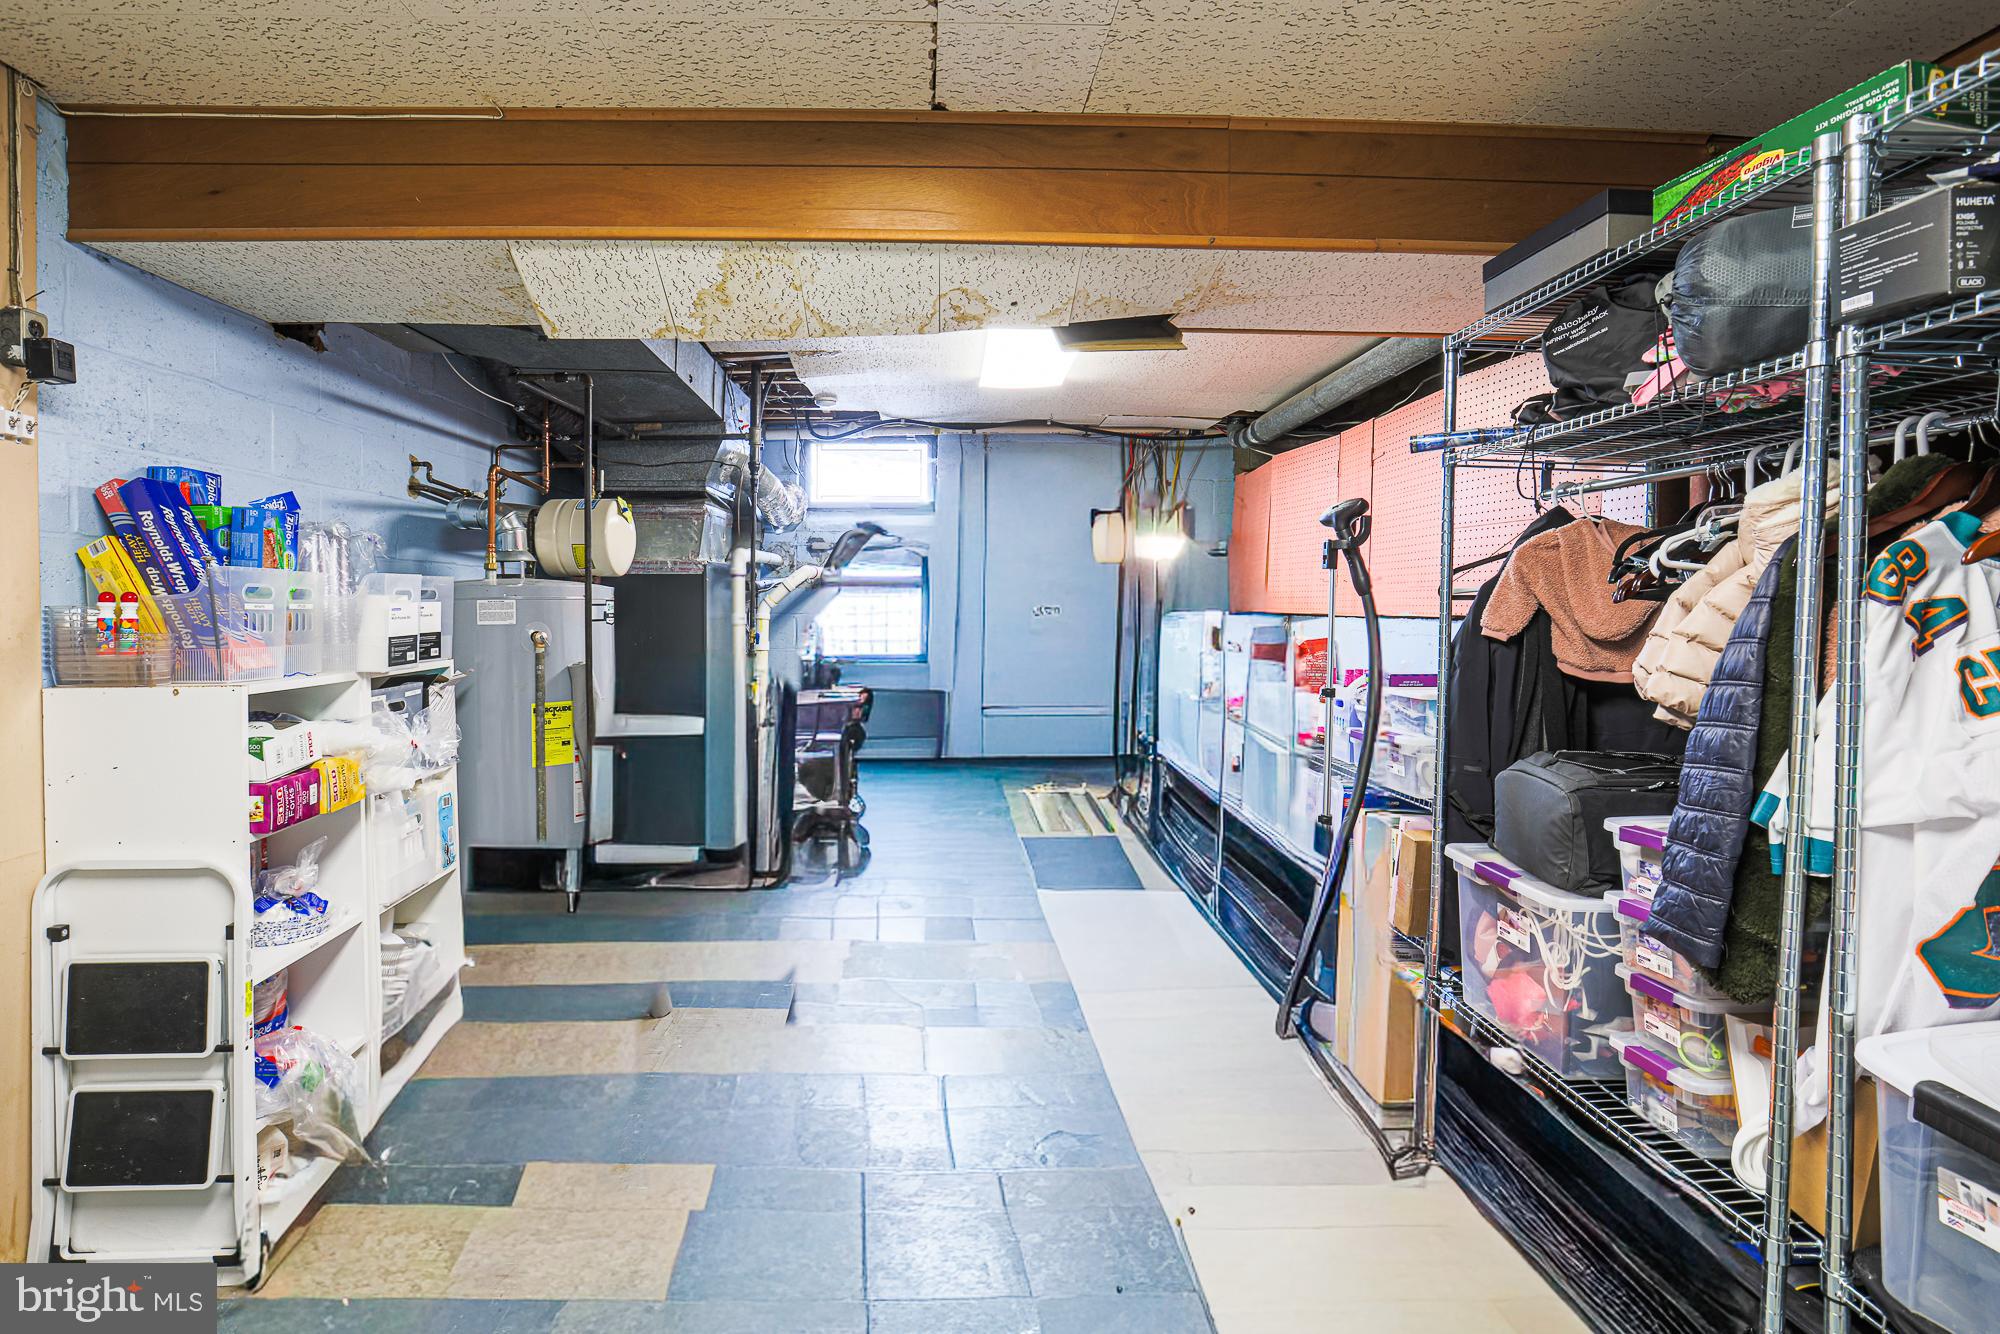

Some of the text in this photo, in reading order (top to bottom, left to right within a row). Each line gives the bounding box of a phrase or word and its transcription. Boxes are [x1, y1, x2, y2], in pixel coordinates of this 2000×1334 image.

[1814, 86, 1900, 133] NO-DIG EDGING KIT
[1845, 79, 1900, 109] EASY TO INSTALL
[1743, 153, 1781, 175] Vigoro
[1956, 196, 1995, 207] HUHETA
[1552, 305, 1599, 334] valcobaby
[1570, 322, 1592, 335] WHEEL
[1591, 309, 1609, 323] PACK
[159, 504, 195, 557] Reynolds
[284, 514, 294, 546] Ziploc
[123, 533, 147, 563] HEAVY
[137, 510, 190, 594] Reynolds Wrap
[162, 598, 197, 649] Reynolds
[189, 597, 213, 628] HEAVY
[306, 731, 314, 758] SOLO
[331, 769, 340, 802] SOLO
[276, 786, 285, 826] SOLO
